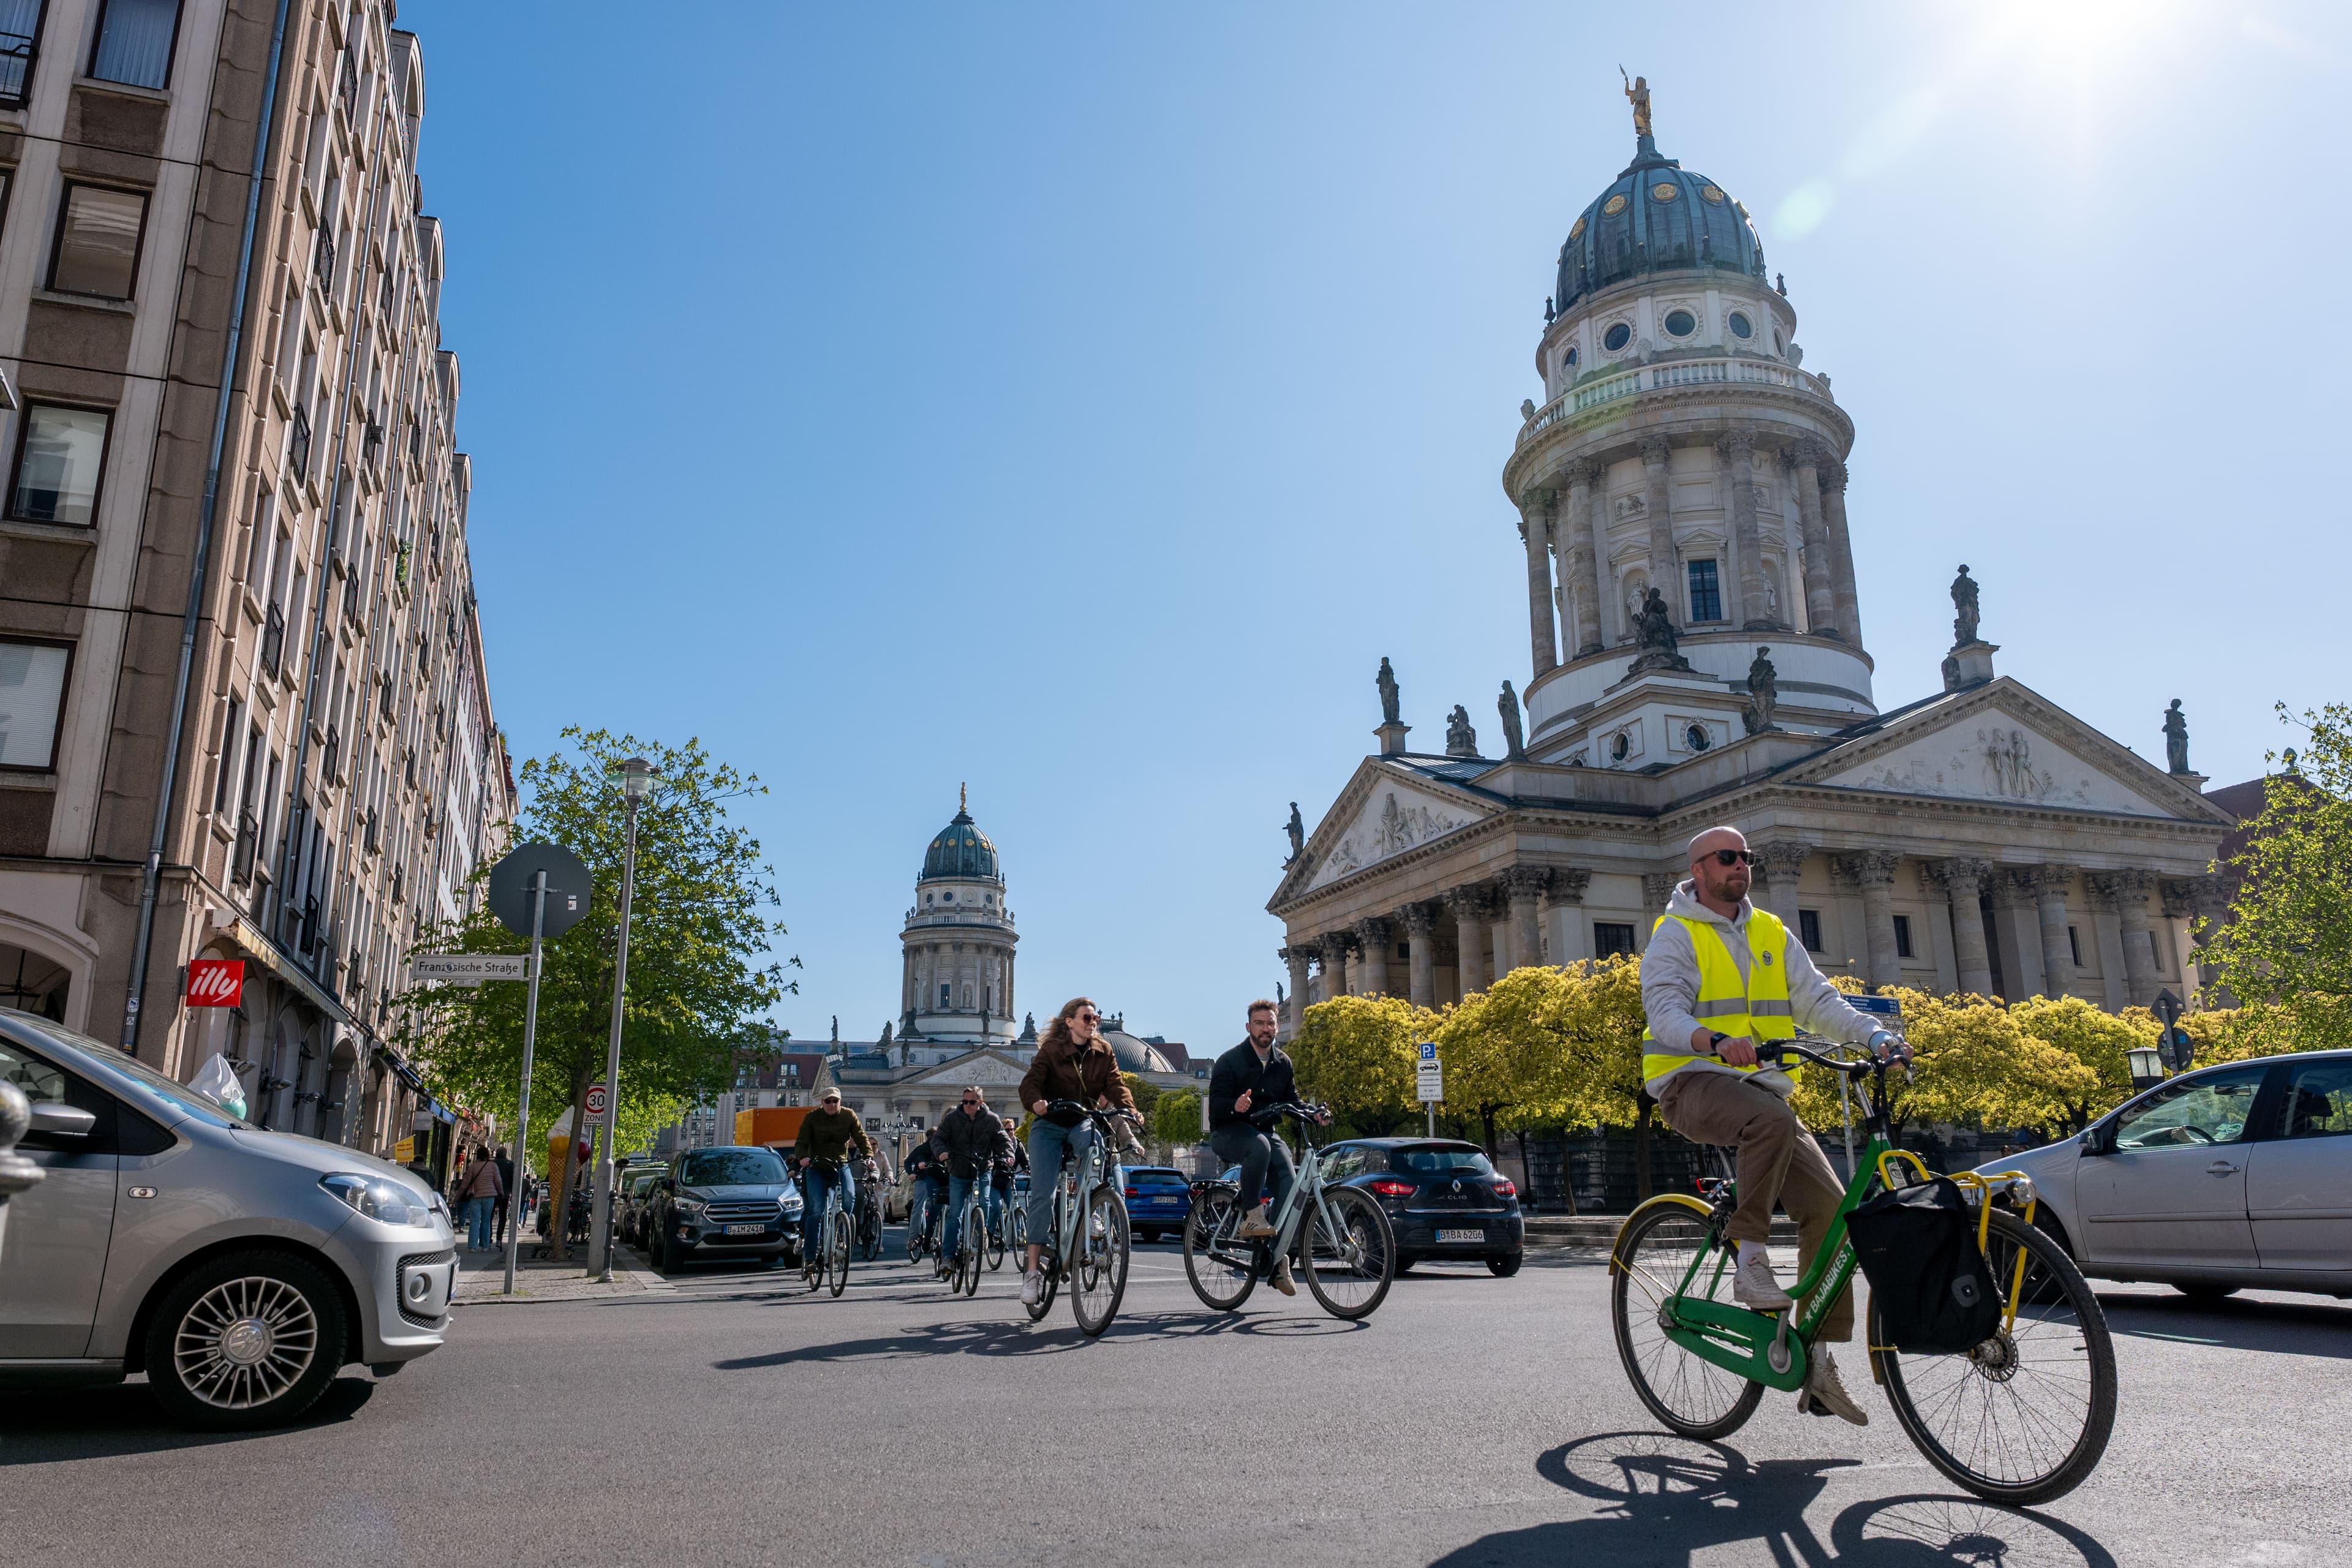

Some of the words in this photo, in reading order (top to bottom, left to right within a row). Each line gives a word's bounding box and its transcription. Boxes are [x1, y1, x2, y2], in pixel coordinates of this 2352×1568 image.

[419, 961, 481, 973] Franzsische
[485, 962, 518, 975] Straße
[190, 967, 238, 1003] illy
[1883, 1020, 1901, 1031] Straße
[1422, 1045, 1431, 1058] P
[589, 1095, 605, 1106] 30
[1440, 1230, 1446, 1239] B
[1450, 1231, 1462, 1239] BA
